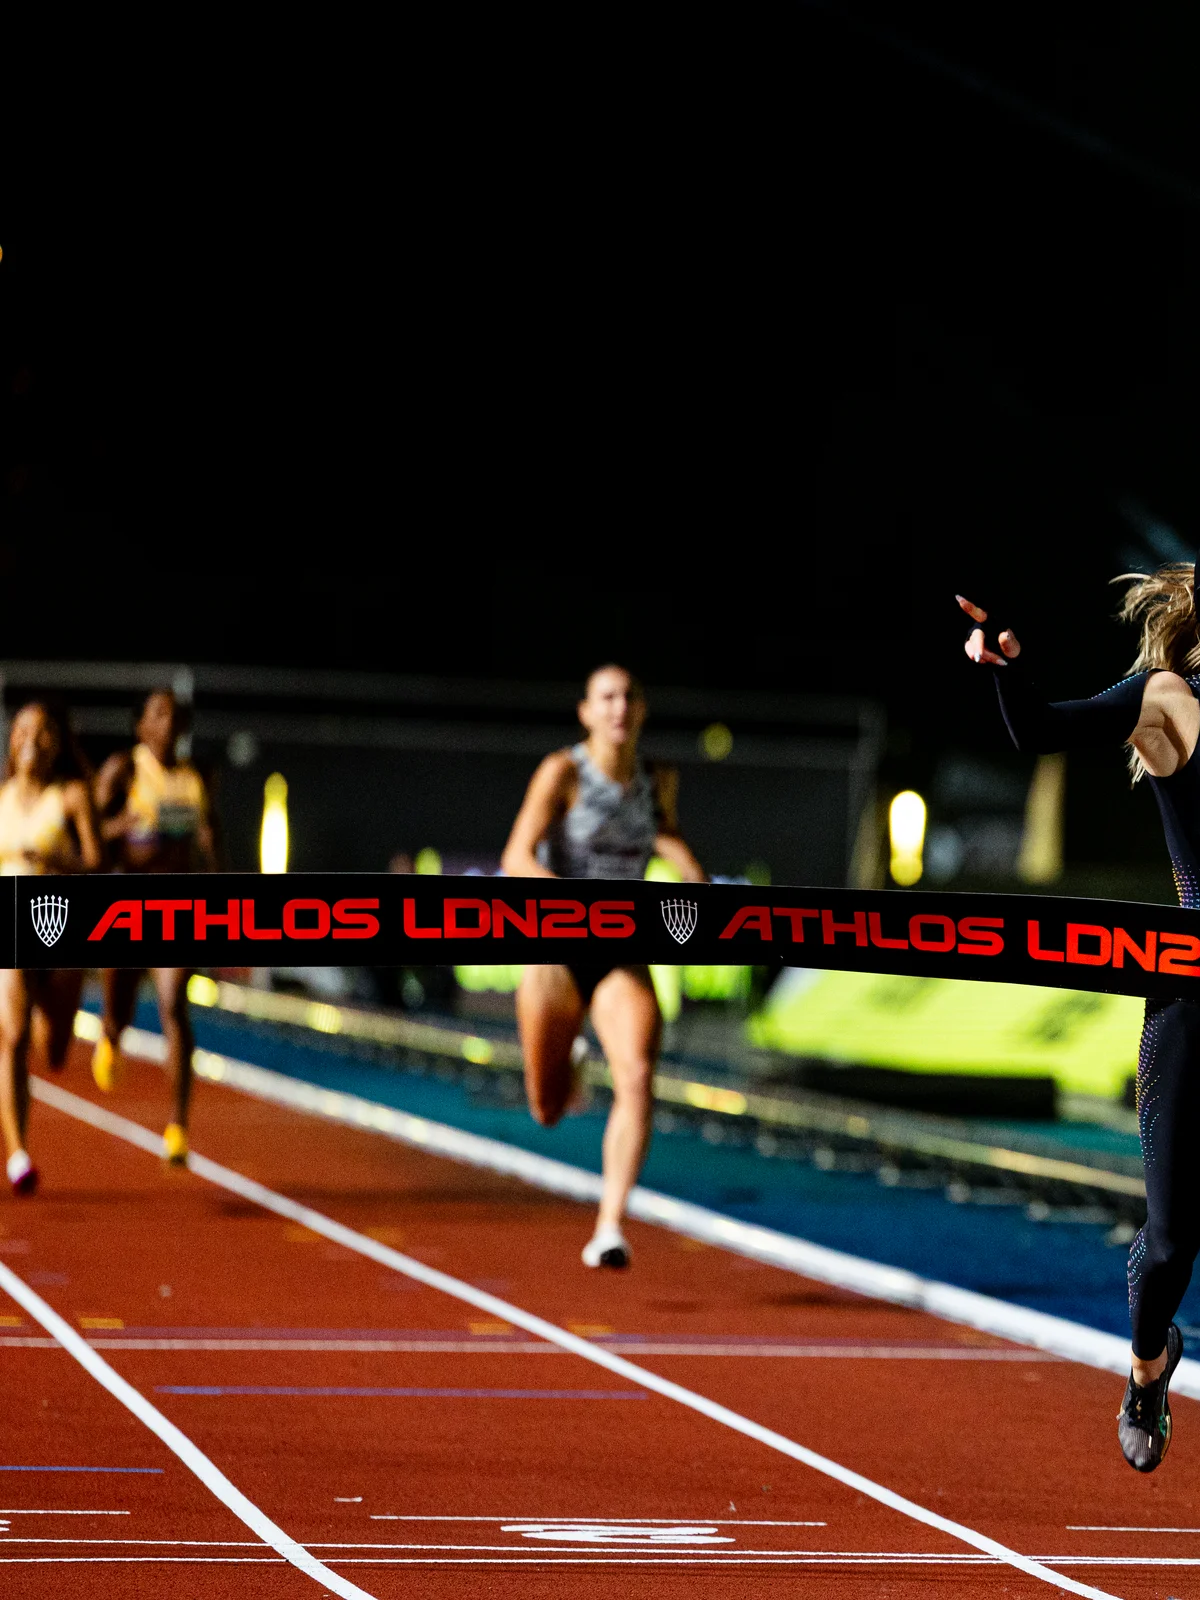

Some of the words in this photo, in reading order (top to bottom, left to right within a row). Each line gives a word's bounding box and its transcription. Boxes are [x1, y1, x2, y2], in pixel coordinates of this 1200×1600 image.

[88, 898, 380, 941] ATHLOS
[403, 898, 636, 939] LDN26
[718, 906, 1004, 955] ATHLOS
